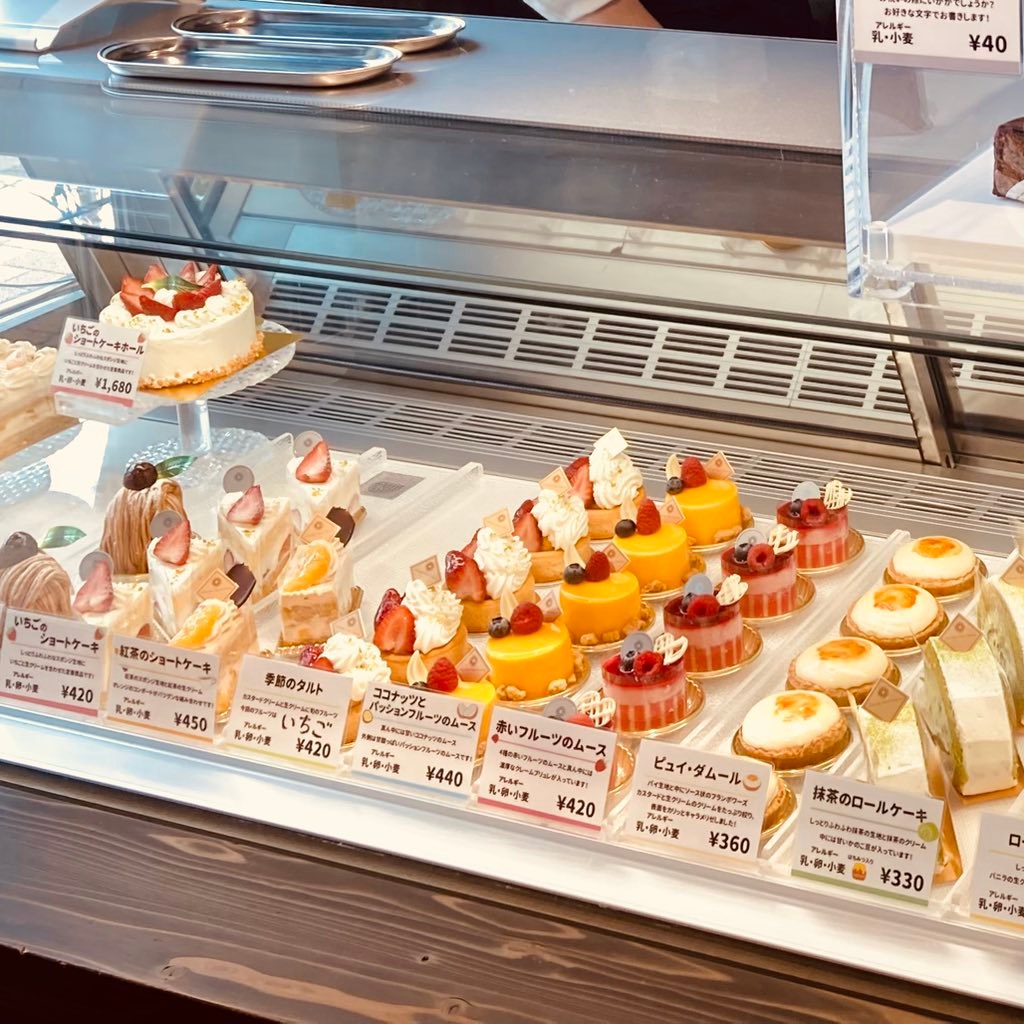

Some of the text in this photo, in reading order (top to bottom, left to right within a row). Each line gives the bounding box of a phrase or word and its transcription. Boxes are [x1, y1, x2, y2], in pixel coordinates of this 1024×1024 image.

[884, 8, 990, 22] お好きな文字でお書きします!
[875, 22, 911, 30] アレルギー
[872, 30, 913, 45] 乳・小麦
[969, 34, 1007, 53] ¥40
[72, 324, 100, 337] いちごの
[73, 334, 144, 355] ショートケーキホール
[95, 377, 132, 394] ¥1,680
[14, 616, 47, 632] いちごの
[41, 634, 99, 653] ショートケーキ
[119, 645, 211, 674] 紅茶のショートケーキ
[265, 673, 323, 695] 季節のタルト
[61, 685, 93, 703] ¥420
[373, 688, 426, 708] ココナッツと
[174, 712, 207, 732] ¥450
[281, 714, 332, 738] いちご
[296, 738, 331, 758] ¥420
[496, 720, 607, 757] 赤いフルーツのムース
[371, 749, 395, 758] アレルギー
[361, 757, 401, 774] 乳・卵・小麦
[654, 756, 741, 785] ピュイ・ダムール
[426, 766, 463, 787] ¥440
[498, 776, 524, 786] アレルギー
[489, 784, 530, 802] 乳・卵・小麦
[557, 795, 595, 818] ¥420
[813, 785, 927, 823] 抹茶のロールケーキ
[647, 812, 673, 823] アレルギー
[636, 821, 680, 839] 乳・卵・小麦
[709, 831, 750, 854] ¥360
[811, 846, 838, 857] アレルギー
[800, 854, 846, 875] 乳・卵・小麦
[880, 867, 924, 892] ¥330
[989, 890, 1018, 902] アレルギー
